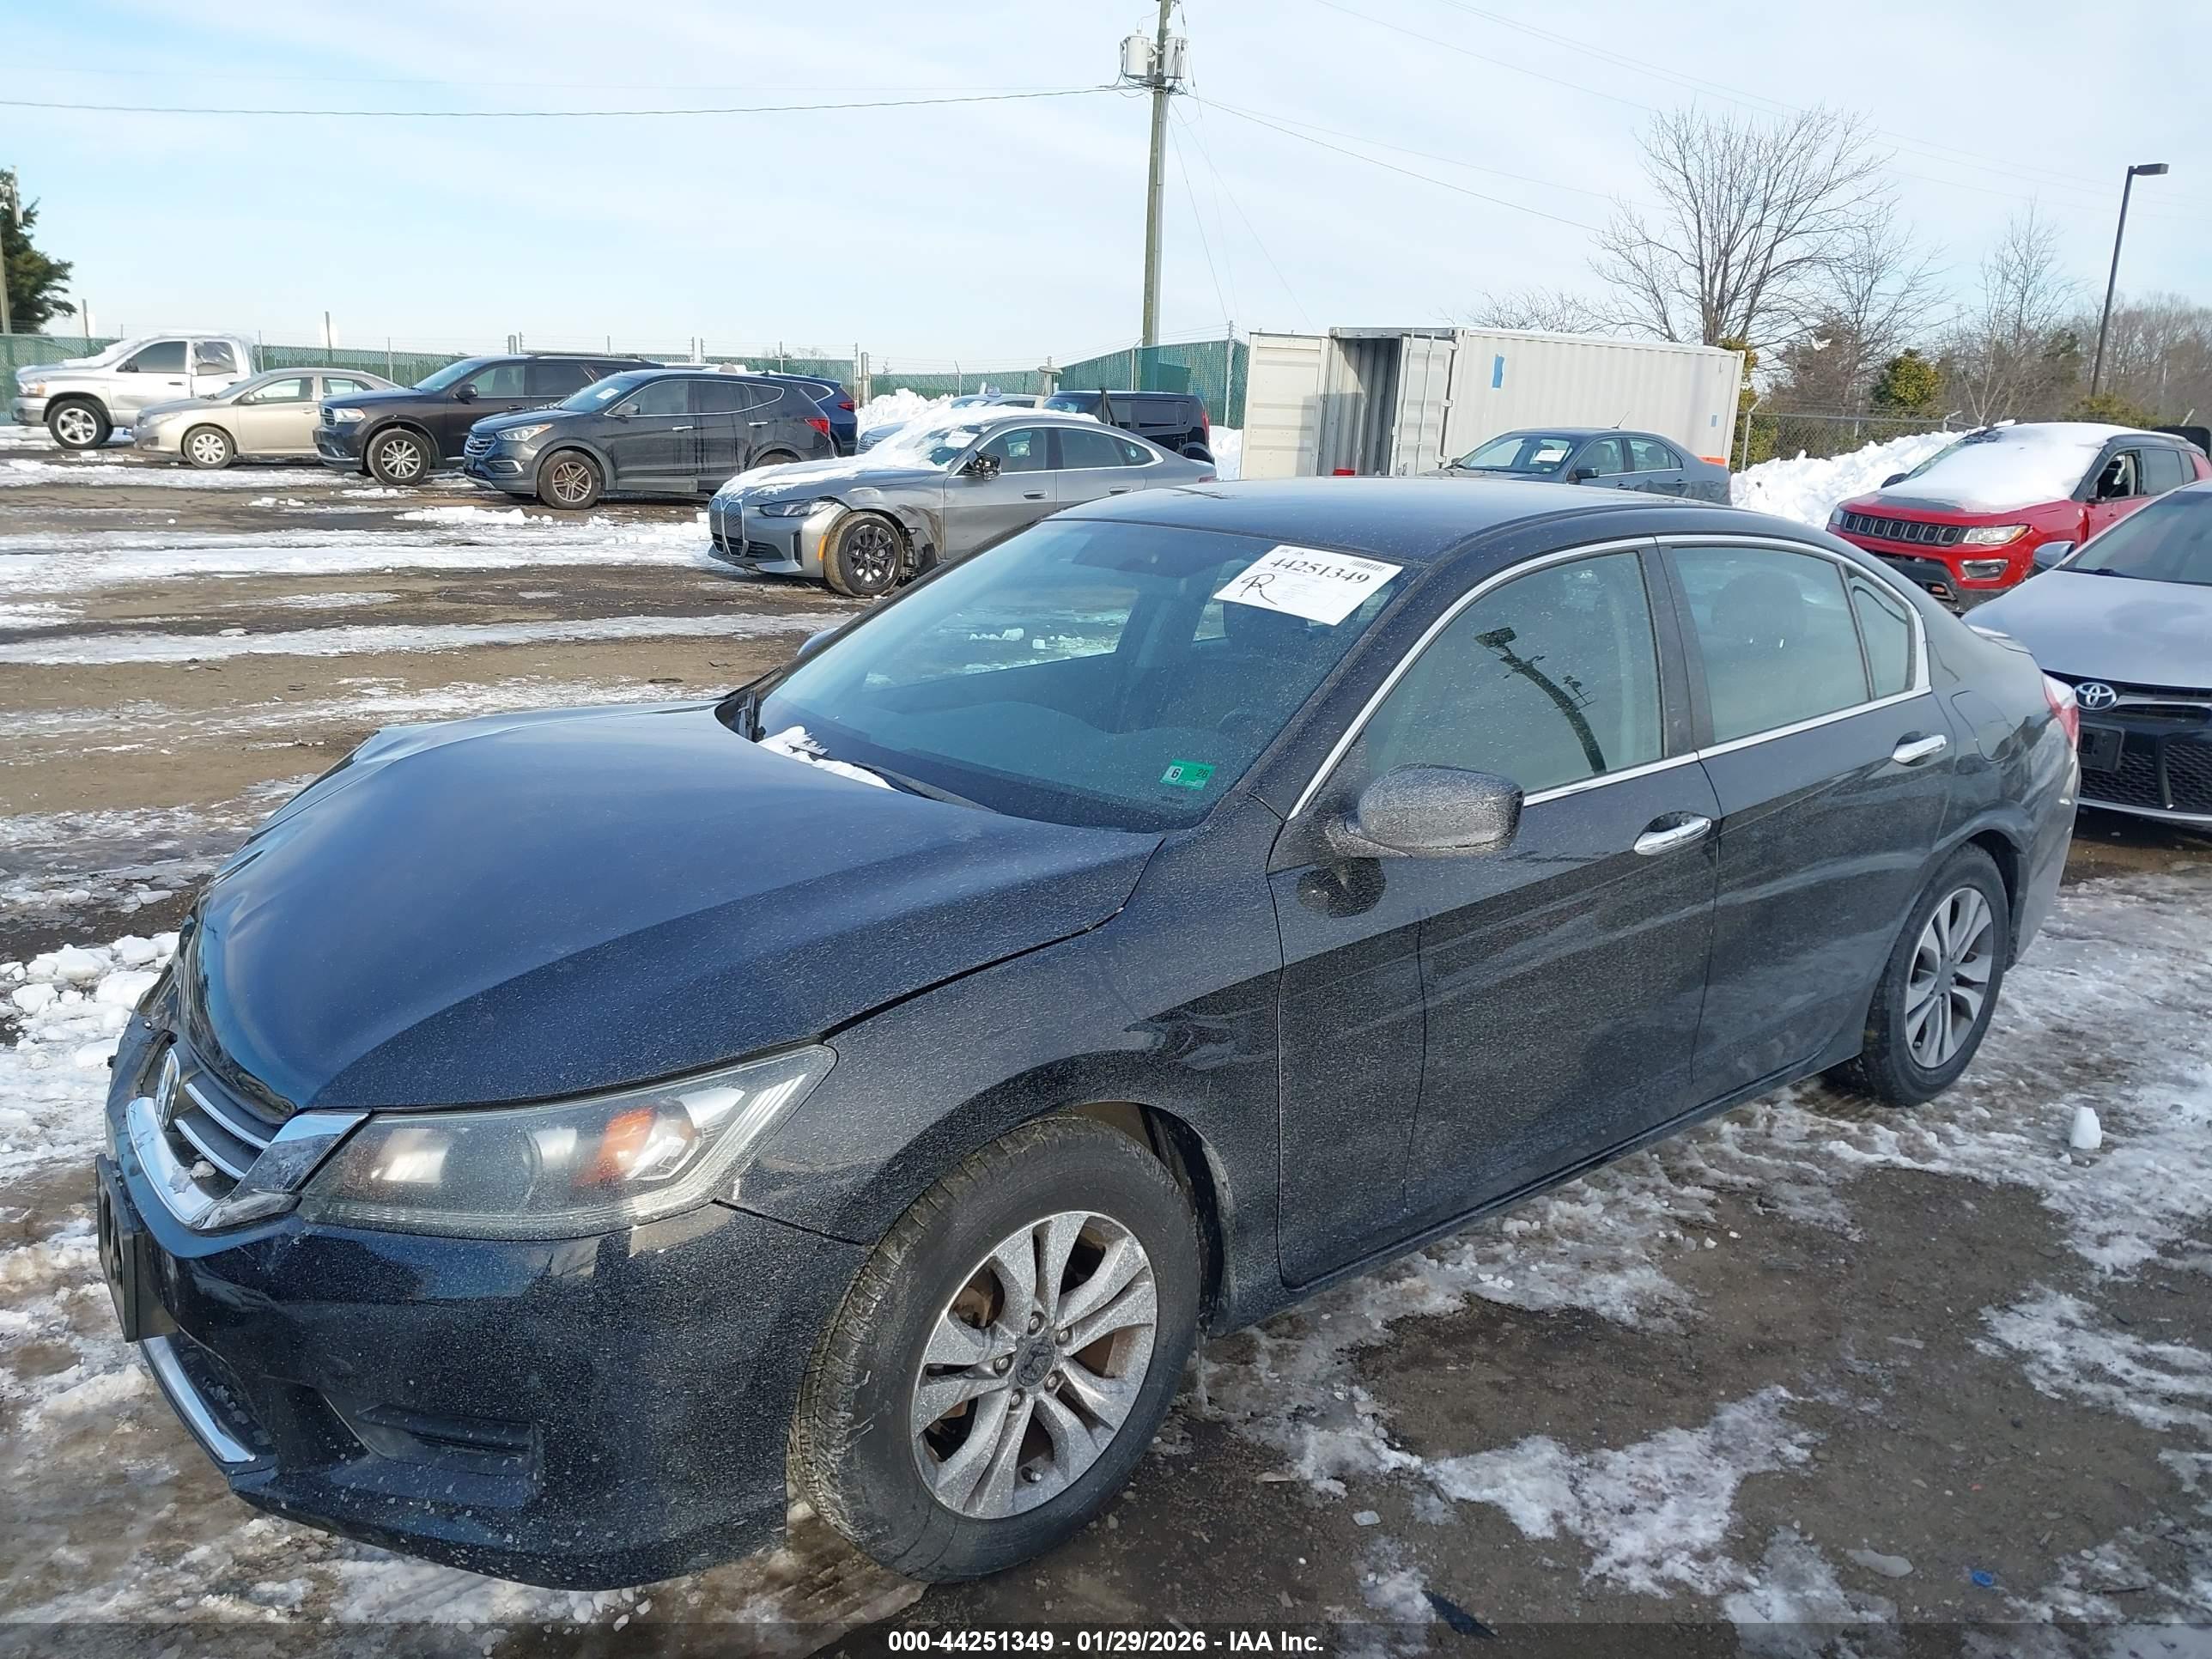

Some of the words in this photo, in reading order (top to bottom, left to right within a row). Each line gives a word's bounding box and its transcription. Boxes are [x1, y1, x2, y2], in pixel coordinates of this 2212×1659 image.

[1270, 558, 1370, 584] 44251349
[1239, 573, 1278, 605] R
[1171, 769, 1182, 779] 6
